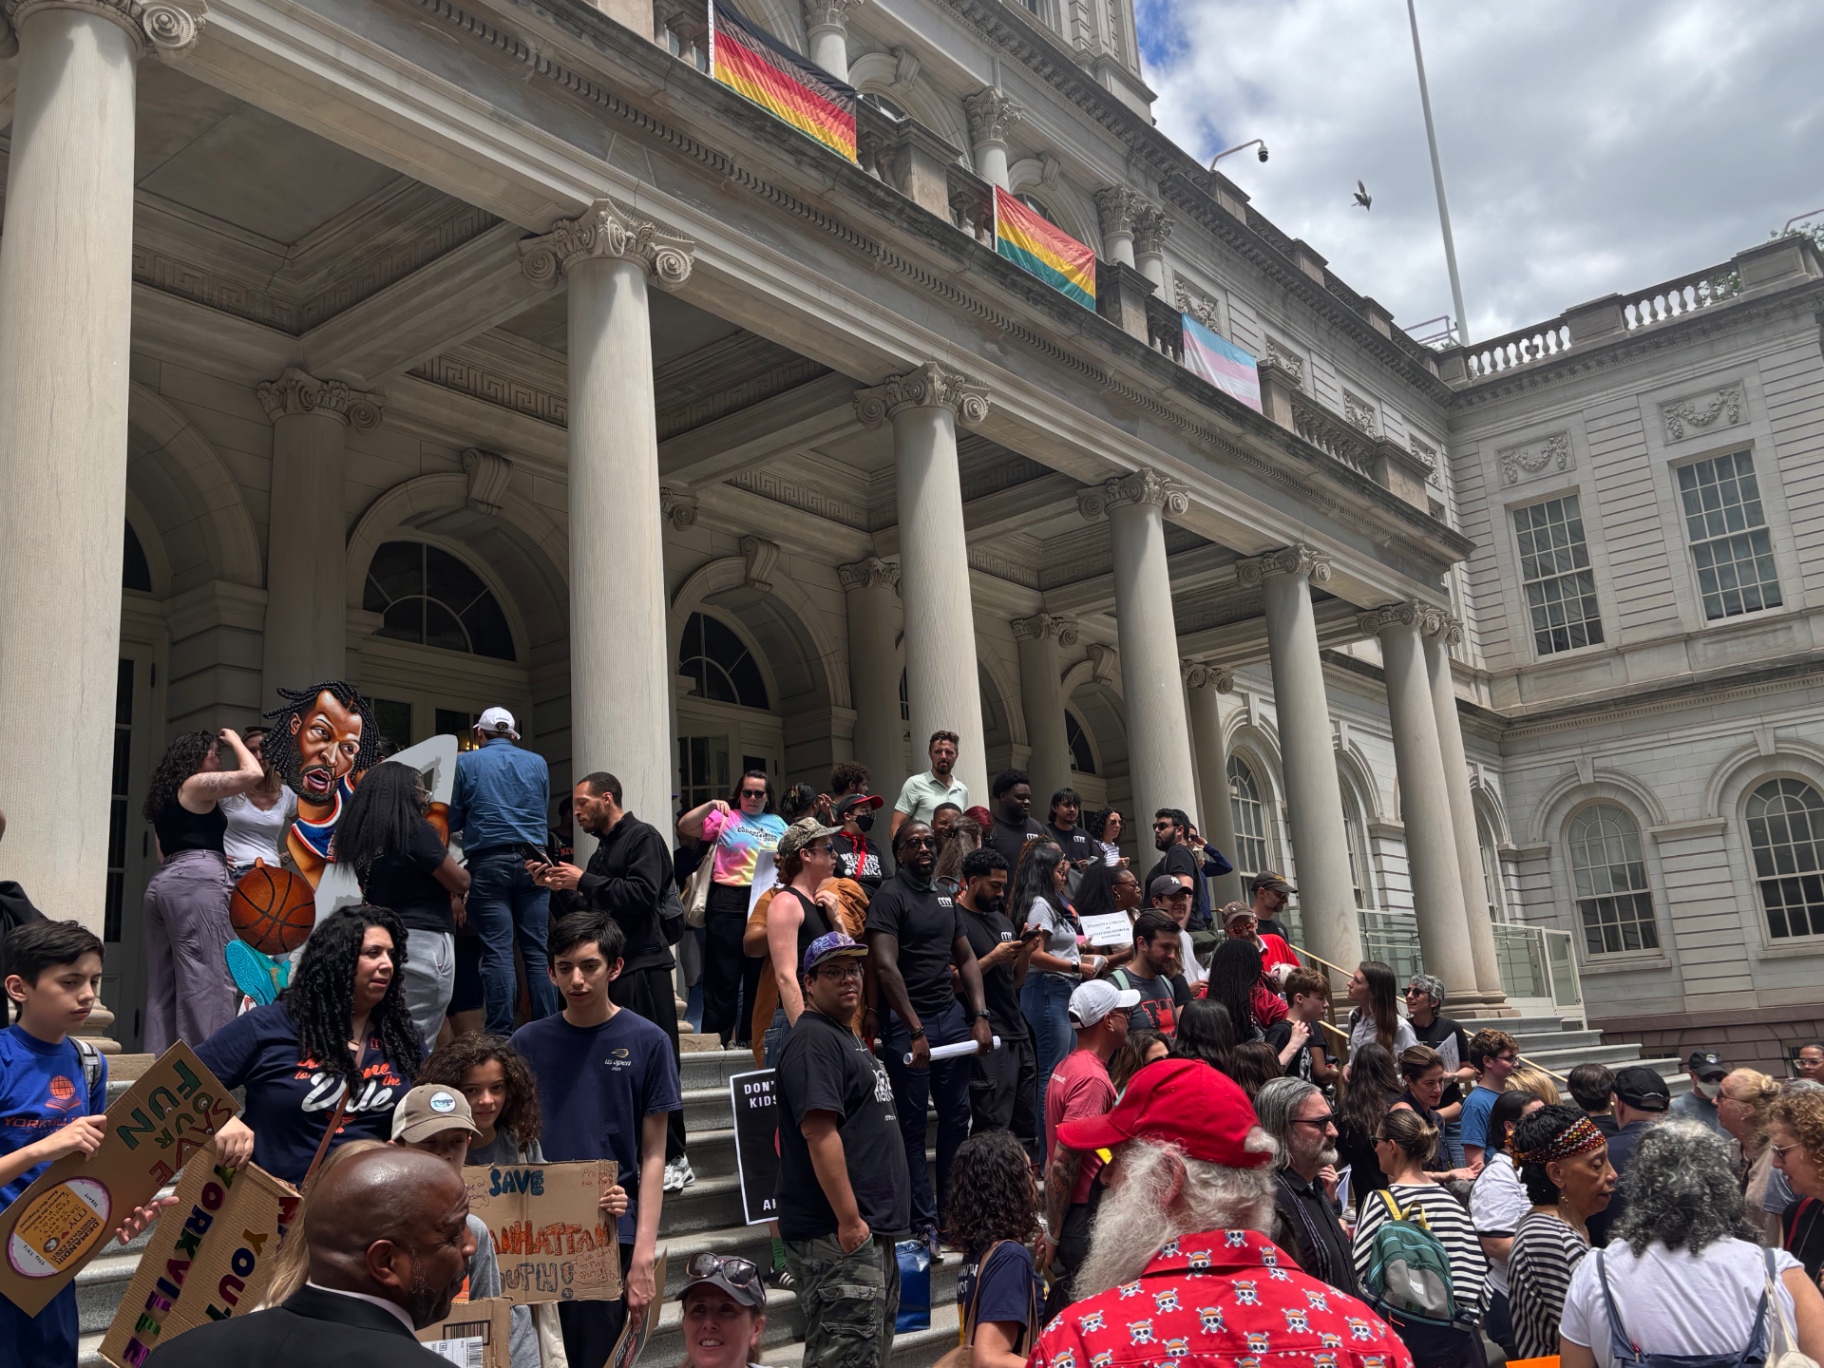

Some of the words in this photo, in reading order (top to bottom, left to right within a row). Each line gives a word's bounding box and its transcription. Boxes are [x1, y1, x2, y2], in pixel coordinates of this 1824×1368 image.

[116, 1059, 202, 1150] FUN
[744, 1080, 775, 1094] DON'
[155, 1092, 213, 1149] OUR
[489, 1168, 545, 1197] SAVE
[56, 1221, 100, 1265] DEMAND!!!
[489, 1220, 611, 1256] ANHATTAN
[123, 1164, 237, 1367] YORKVILLE
[205, 1228, 268, 1321] YOUT
[499, 1262, 574, 1299] OUTH!
